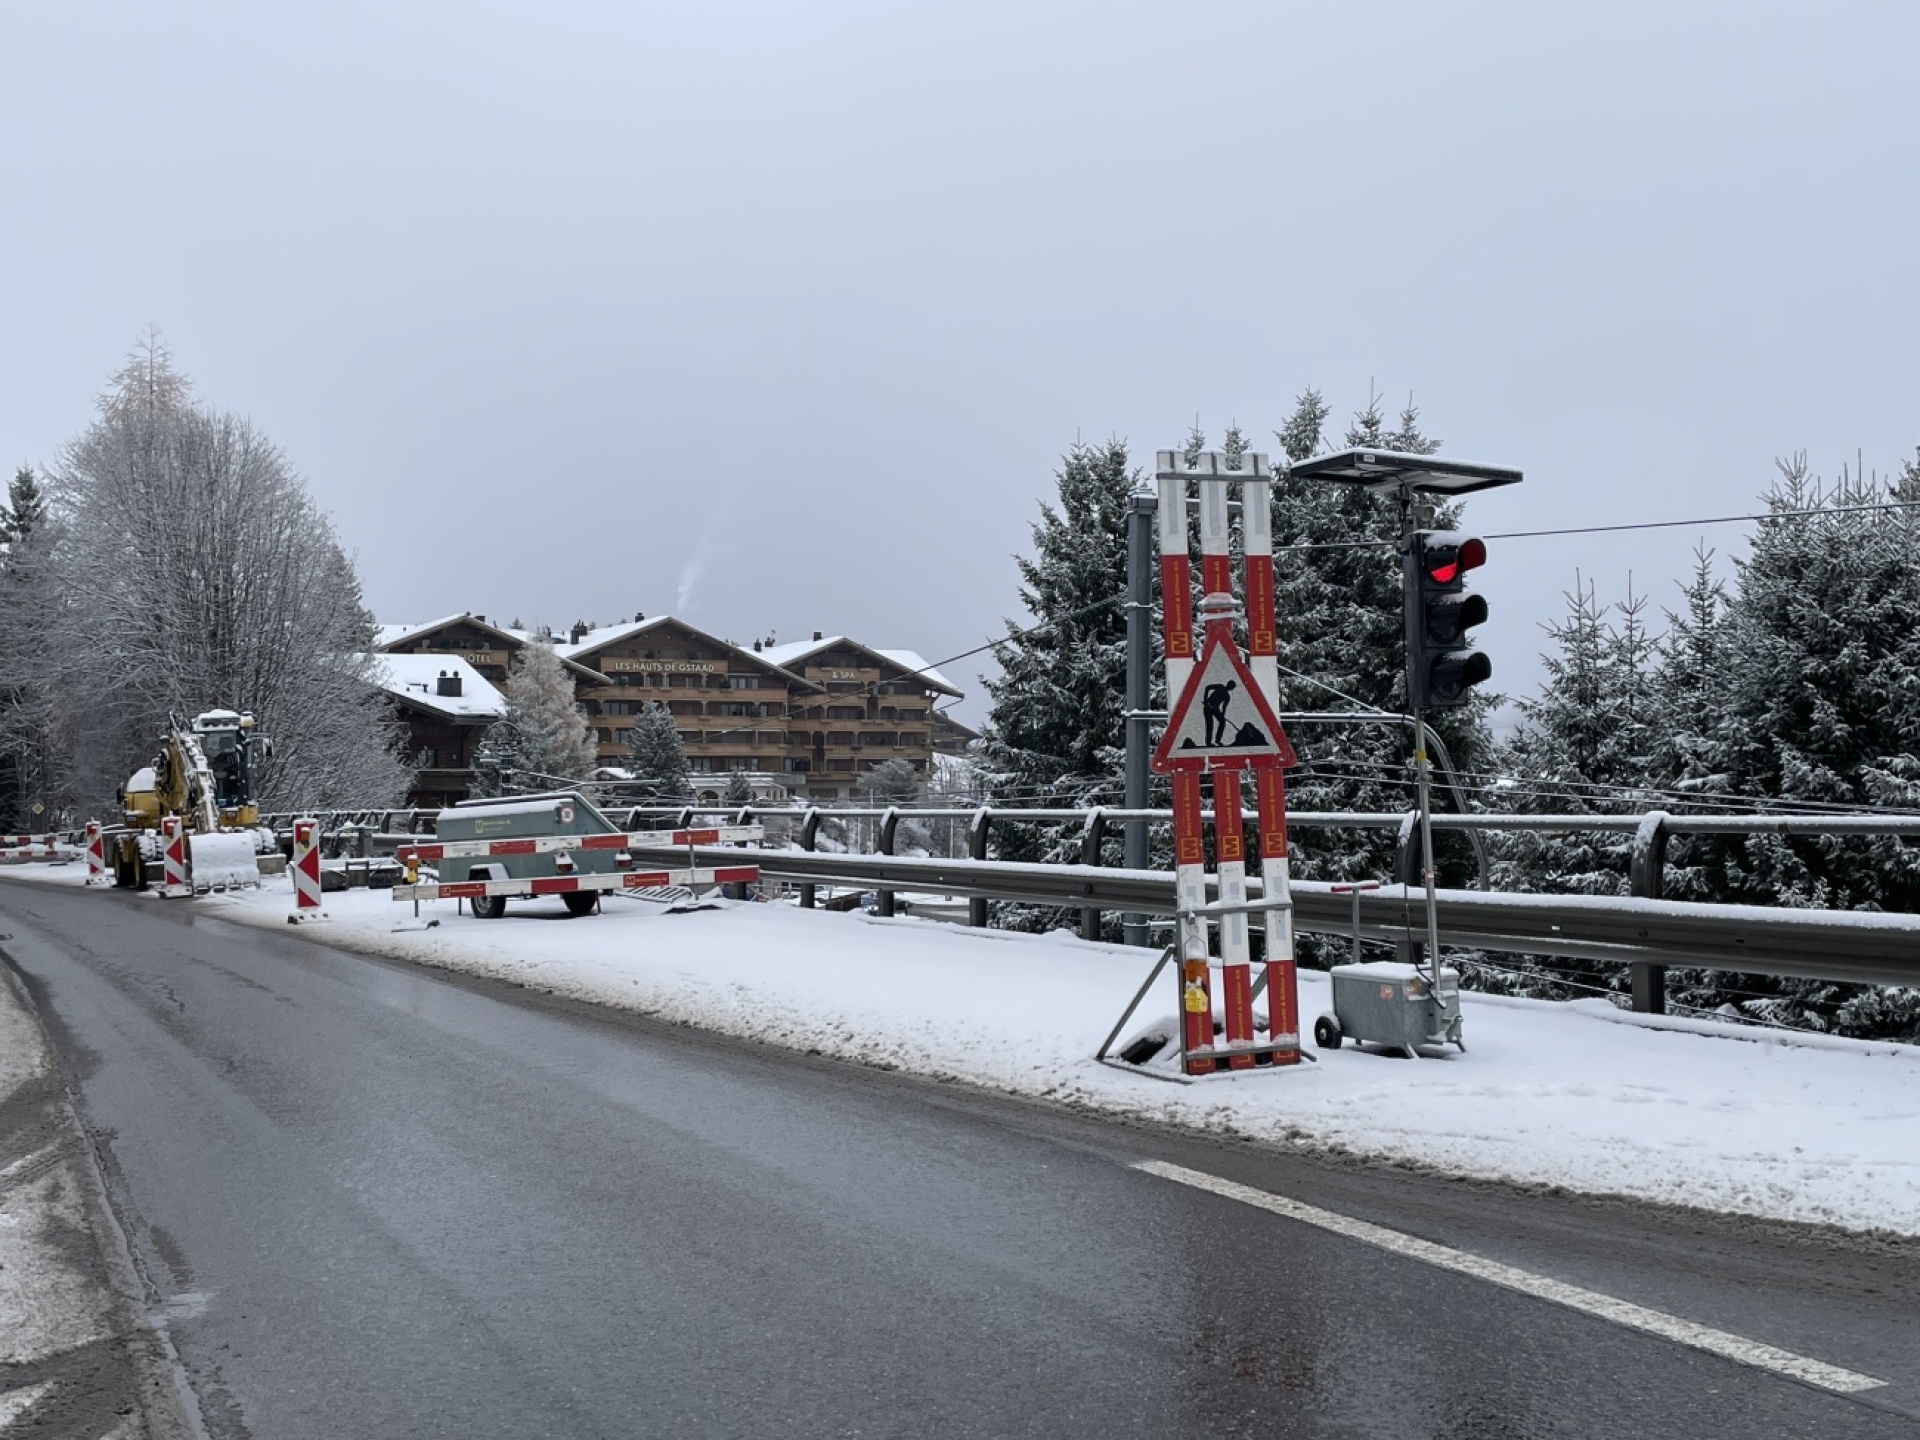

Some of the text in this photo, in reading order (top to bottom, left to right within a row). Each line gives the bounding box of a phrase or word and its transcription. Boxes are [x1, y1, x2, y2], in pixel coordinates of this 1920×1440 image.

[615, 662, 715, 672] LES HAUTS DE GSTAAD
[840, 671, 855, 679] SPA
